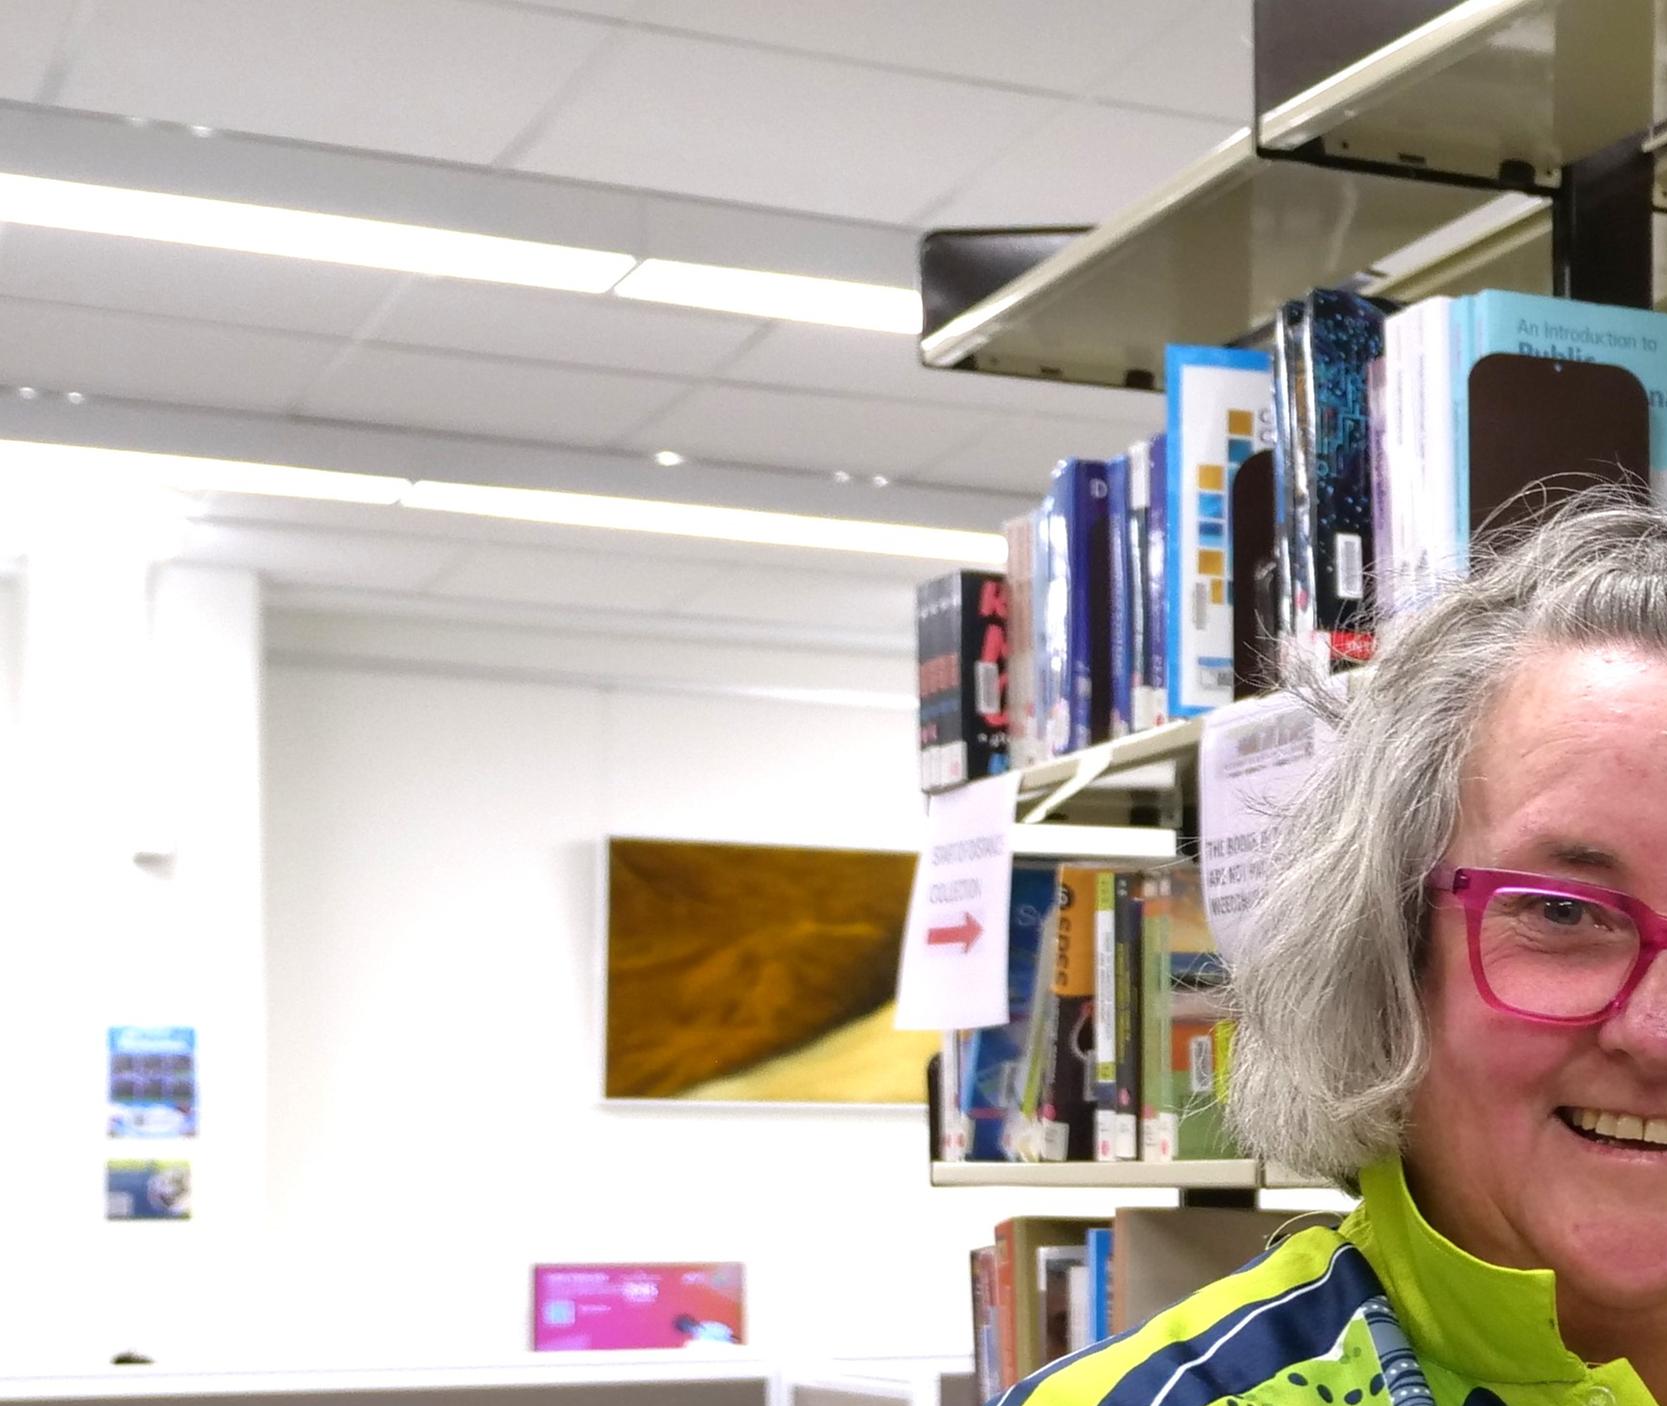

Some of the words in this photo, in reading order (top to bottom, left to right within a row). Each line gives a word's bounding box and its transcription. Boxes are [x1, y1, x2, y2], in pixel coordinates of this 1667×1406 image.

[1516, 317, 1541, 335] An
[1543, 320, 1637, 348] Introduction
[1640, 333, 1658, 348] to
